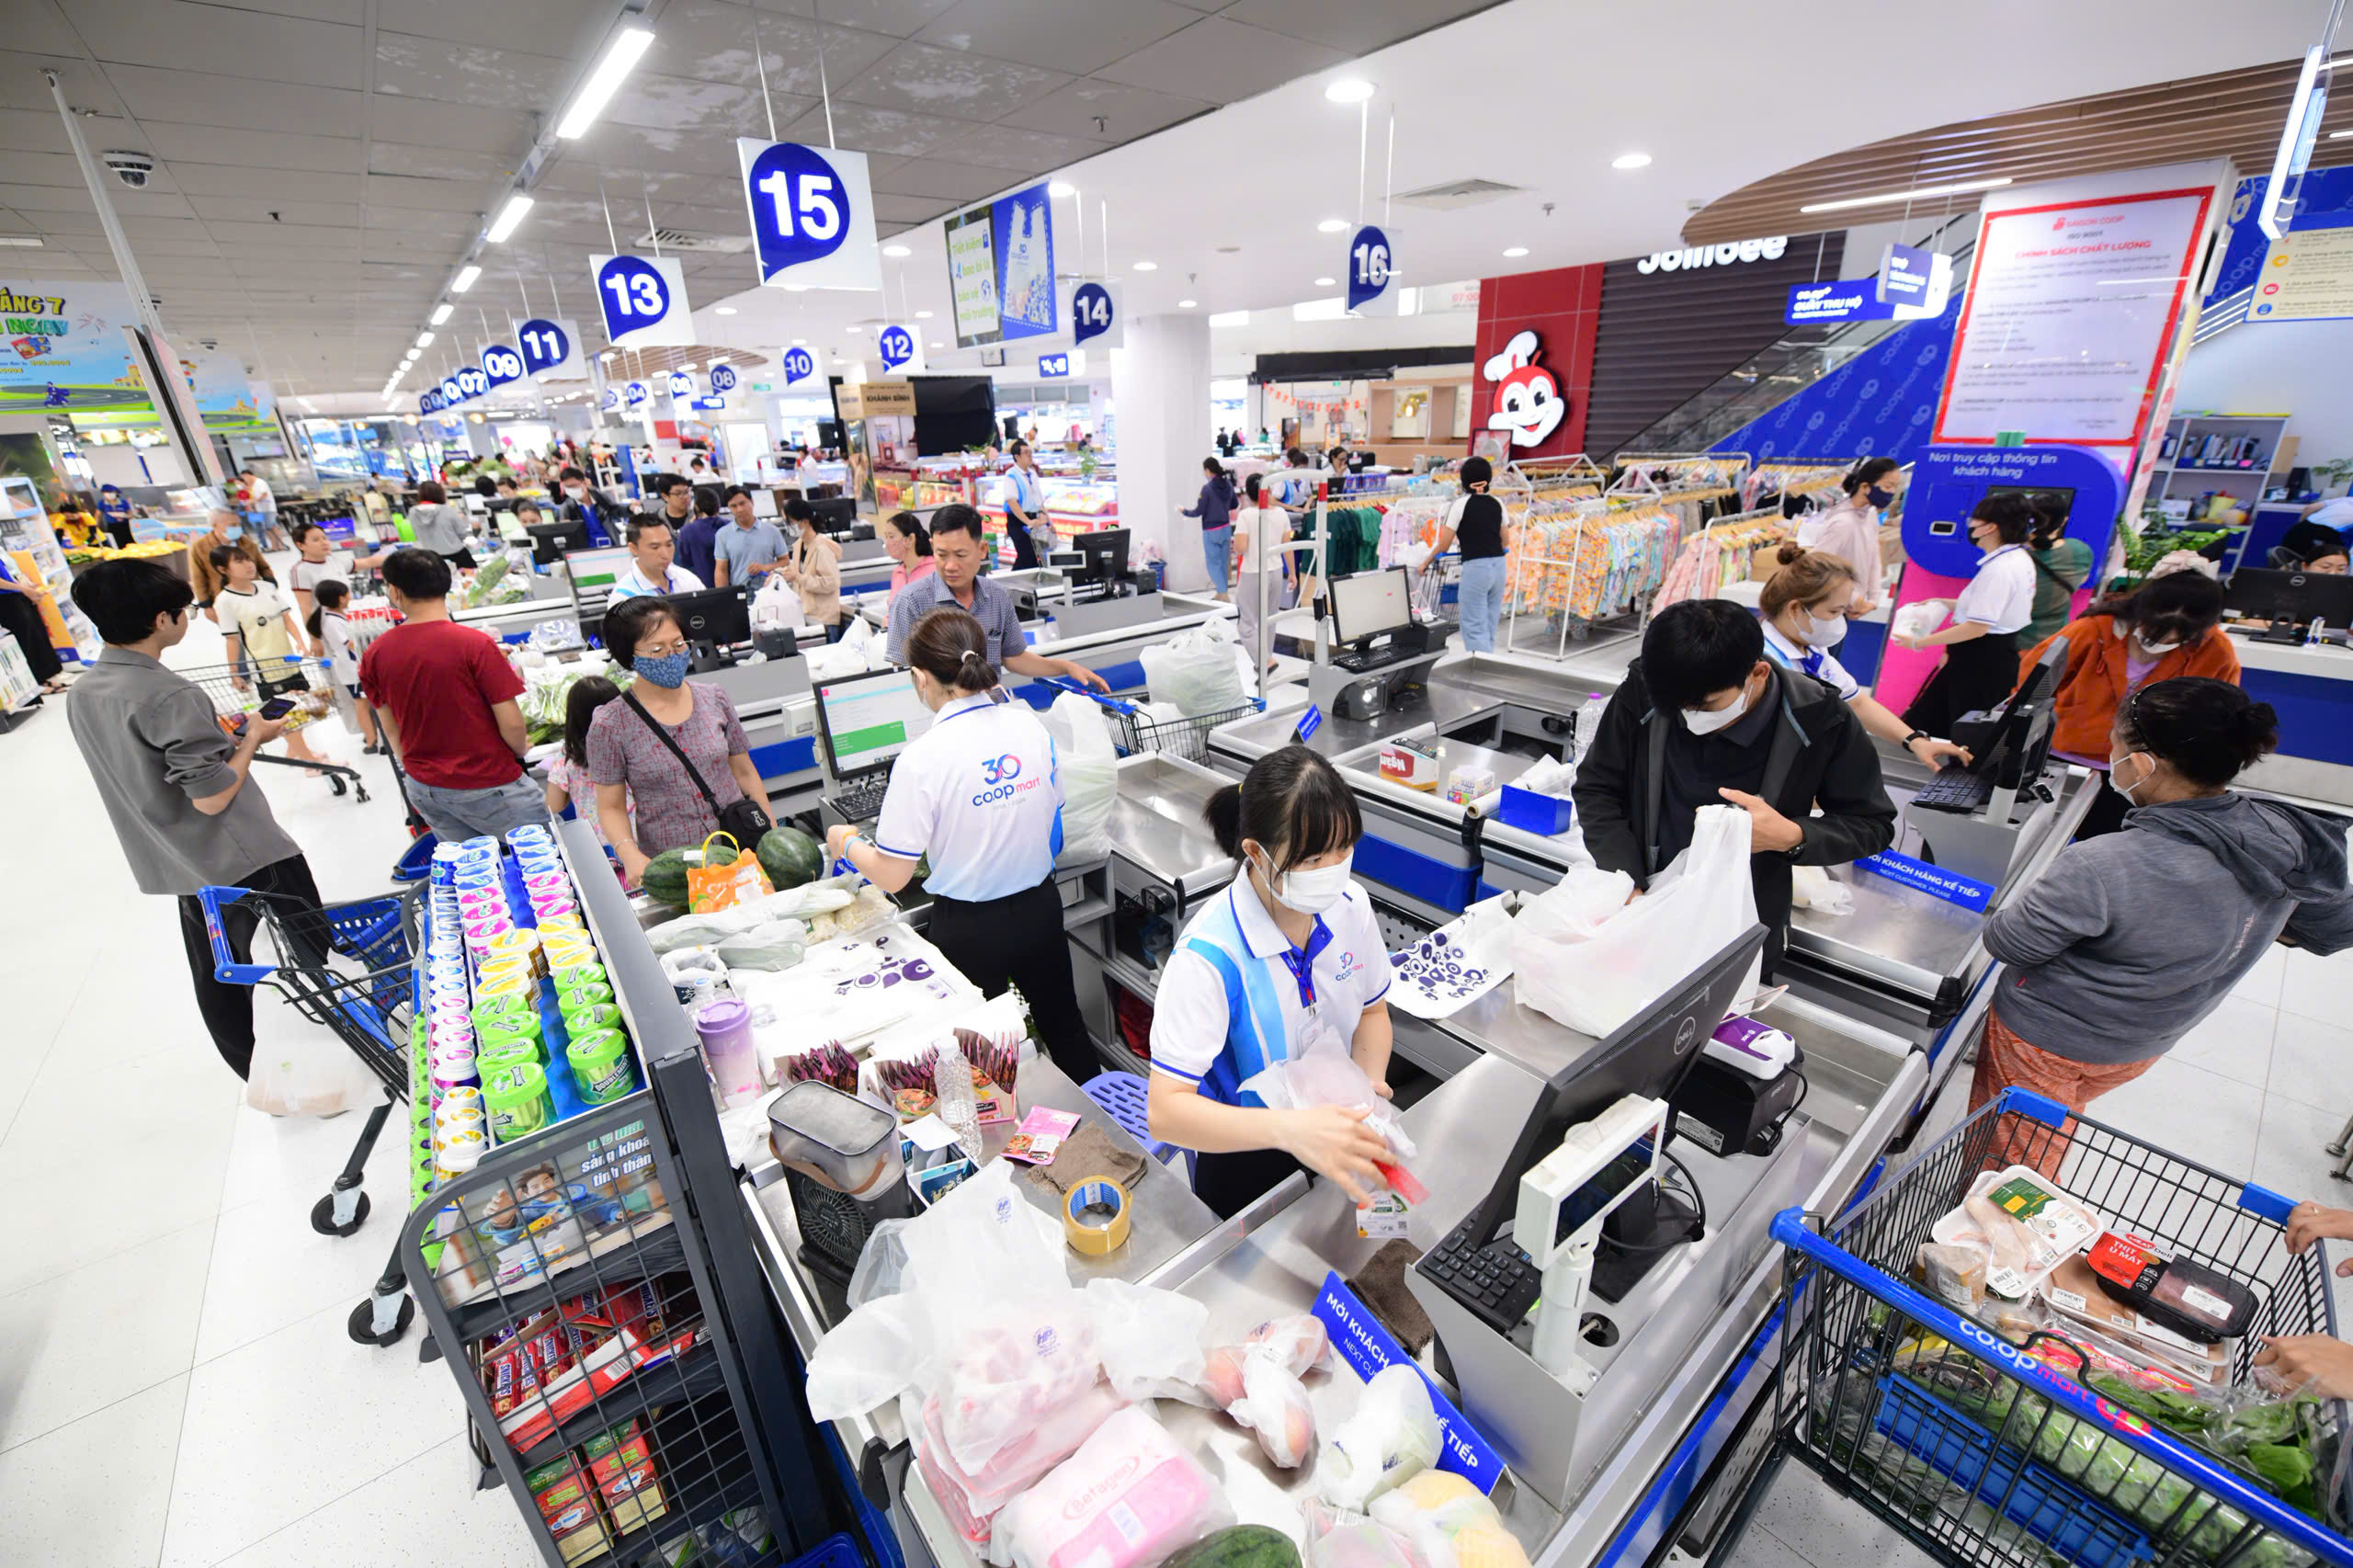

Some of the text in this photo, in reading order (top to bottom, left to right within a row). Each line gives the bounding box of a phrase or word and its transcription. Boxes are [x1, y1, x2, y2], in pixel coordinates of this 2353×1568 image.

[758, 170, 840, 240] 15
[1354, 243, 1388, 287] 16
[46, 296, 65, 315] 7
[606, 273, 664, 315] 13
[1077, 296, 1109, 326] 14
[523, 330, 562, 359] 11
[882, 335, 911, 358] 12
[484, 353, 521, 378] 09
[787, 355, 810, 374] 10
[444, 381, 460, 400] 0
[459, 372, 487, 393] 07
[712, 371, 734, 387] 08
[628, 387, 646, 400] 04
[867, 392, 892, 403] KHÁNH
[892, 392, 910, 403] BÌNH
[1928, 451, 1950, 462] Nơi
[1952, 453, 1976, 465] truy
[2003, 452, 2039, 466] thông
[2040, 454, 2058, 464] tin
[1953, 465, 2023, 480] khách hàng
[982, 753, 1022, 785] 30
[1881, 858, 1915, 875] KHÁCH
[1914, 869, 1943, 886] HÀNG
[1942, 879, 1960, 891] KẾ
[1958, 884, 1981, 899] TIẾP
[1677, 1028, 1694, 1047] DELL
[1326, 1290, 1391, 1369] MỜI KHÁCH
[544, 1337, 556, 1368] SNICKES
[1343, 1337, 1364, 1362] NEXT
[1447, 1428, 1479, 1469] TIẾP
